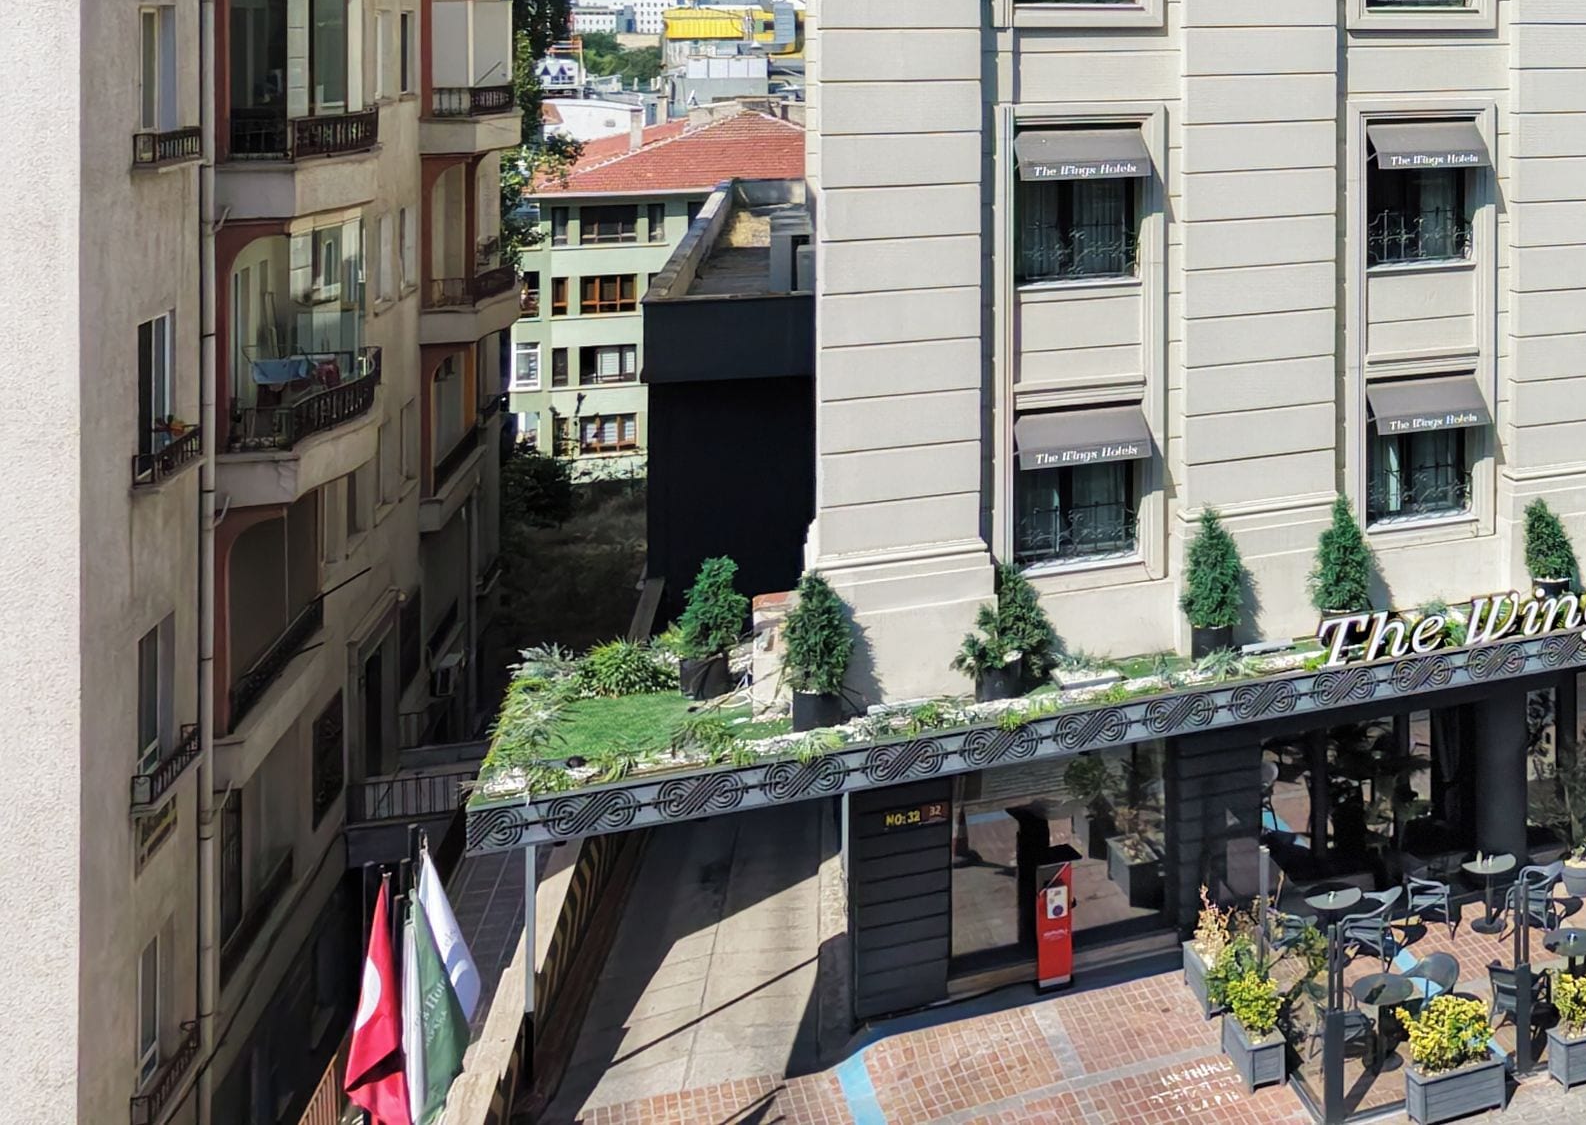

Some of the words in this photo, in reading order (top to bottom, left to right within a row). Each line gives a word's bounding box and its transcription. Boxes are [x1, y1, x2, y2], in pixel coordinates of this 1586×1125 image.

[1390, 155, 1411, 166] The
[1033, 166, 1057, 176] The
[1060, 165, 1097, 178] Wings
[1100, 163, 1137, 175] Hotels
[1389, 420, 1410, 431] The
[1035, 453, 1059, 465] The
[1062, 450, 1098, 462] Wings
[1101, 444, 1139, 457] Hotels
[1318, 610, 1446, 668] The
[929, 804, 942, 817] 32
